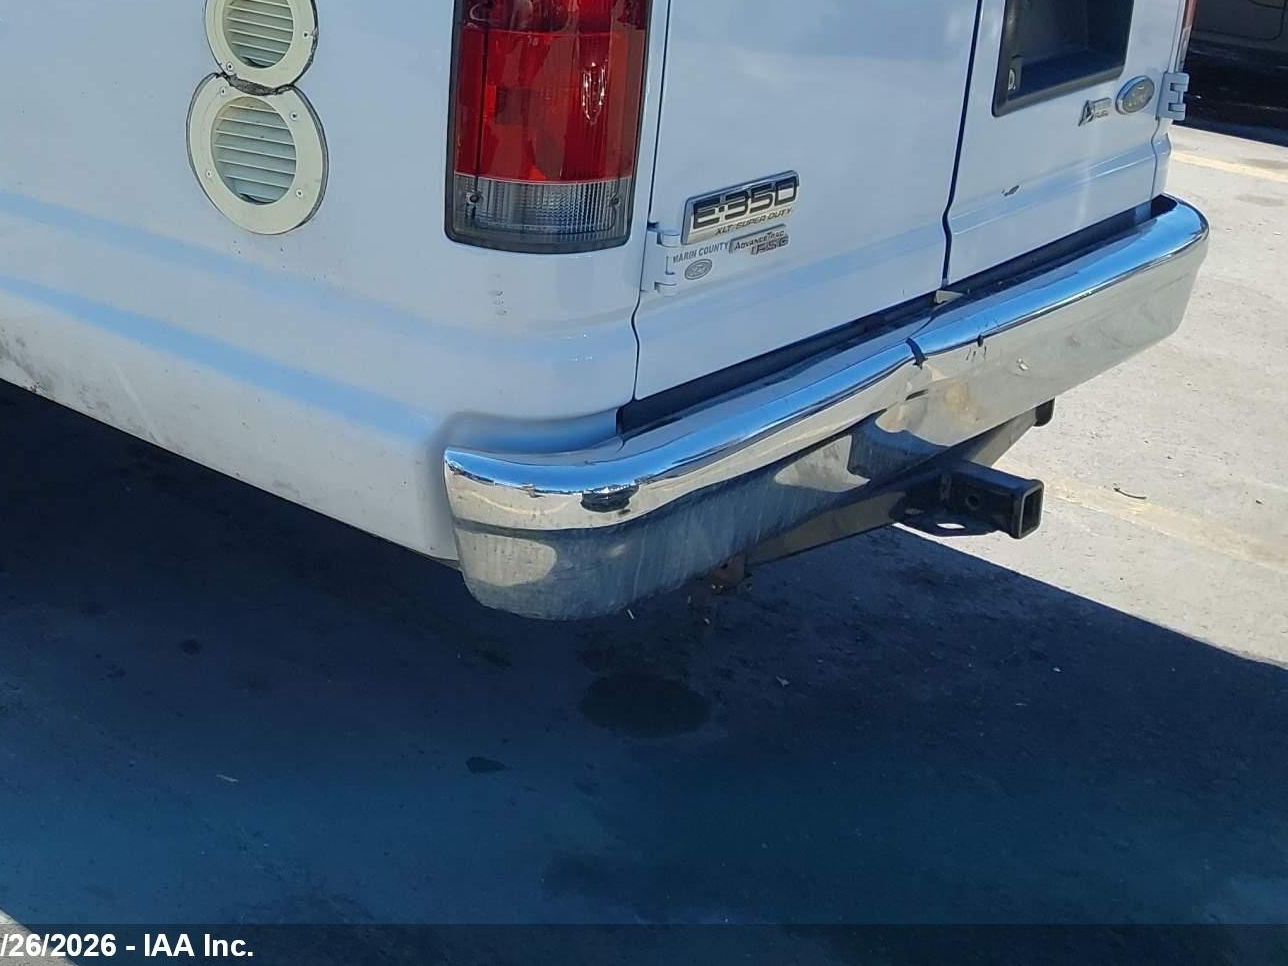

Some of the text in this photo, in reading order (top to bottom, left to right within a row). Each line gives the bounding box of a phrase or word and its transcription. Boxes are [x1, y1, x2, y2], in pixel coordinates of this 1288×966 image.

[715, 207, 793, 236] XLT SUPER DUTY
[673, 240, 730, 264] MARIN COUNTY
